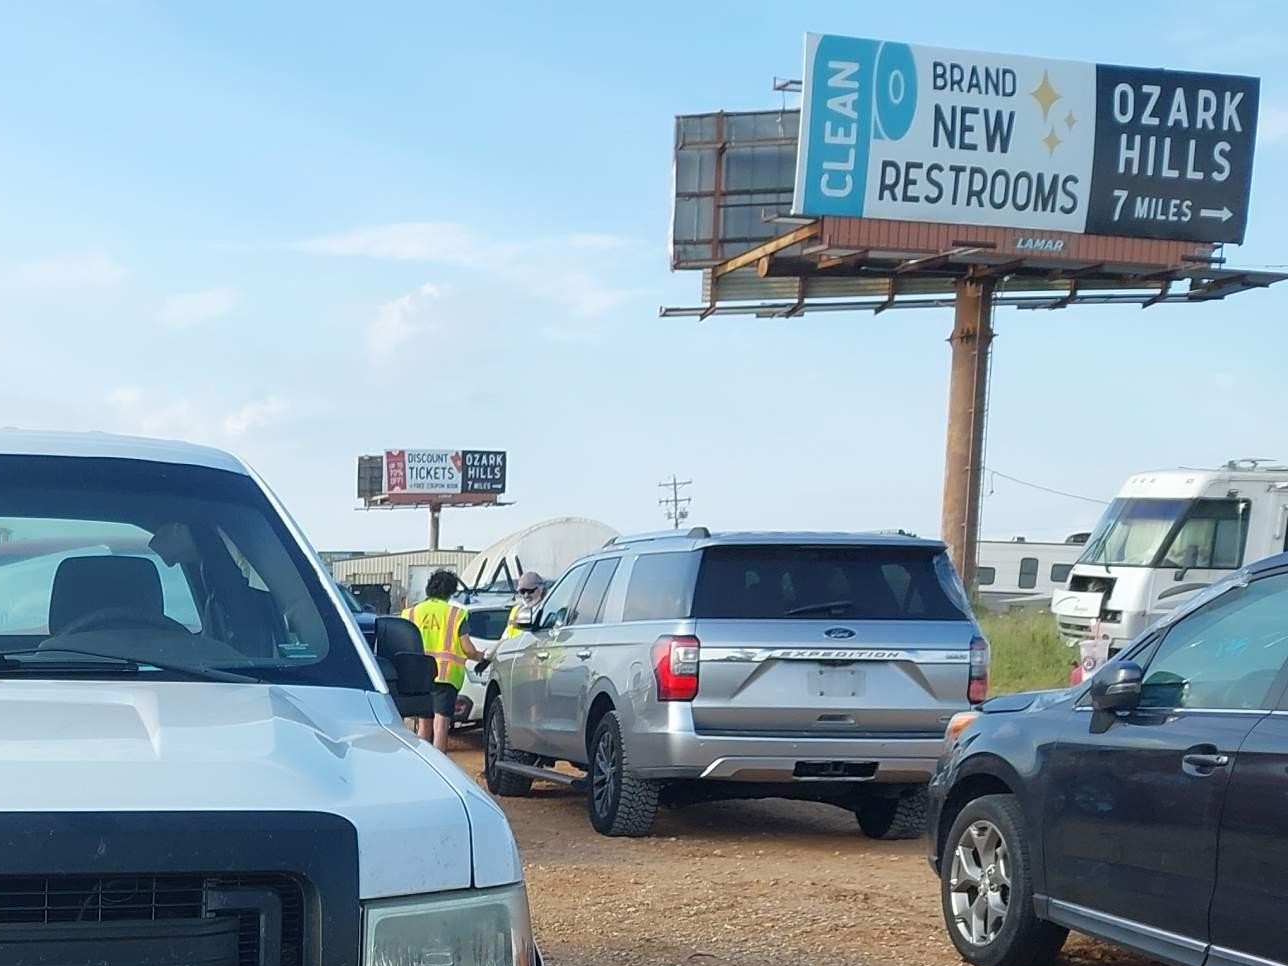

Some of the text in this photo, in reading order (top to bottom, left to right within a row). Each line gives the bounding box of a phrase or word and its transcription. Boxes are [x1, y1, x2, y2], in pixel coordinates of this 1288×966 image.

[932, 61, 1017, 97] BRAND
[1114, 83, 1244, 132] OZARK
[820, 60, 860, 198] CLEAN
[932, 103, 1016, 153] NEW
[1118, 133, 1232, 182] HILLS
[878, 159, 1080, 215] RESTROOMS
[1113, 190, 1193, 222] 7 MILES
[1016, 238, 1064, 251] LAMAR
[408, 453, 448, 464] DISCOUNT
[466, 453, 503, 466] OZARK
[409, 466, 454, 480] TICKETS
[468, 467, 501, 479] HILLS
[467, 480, 473, 490] 7
[780, 651, 900, 659] EXPEDITION
